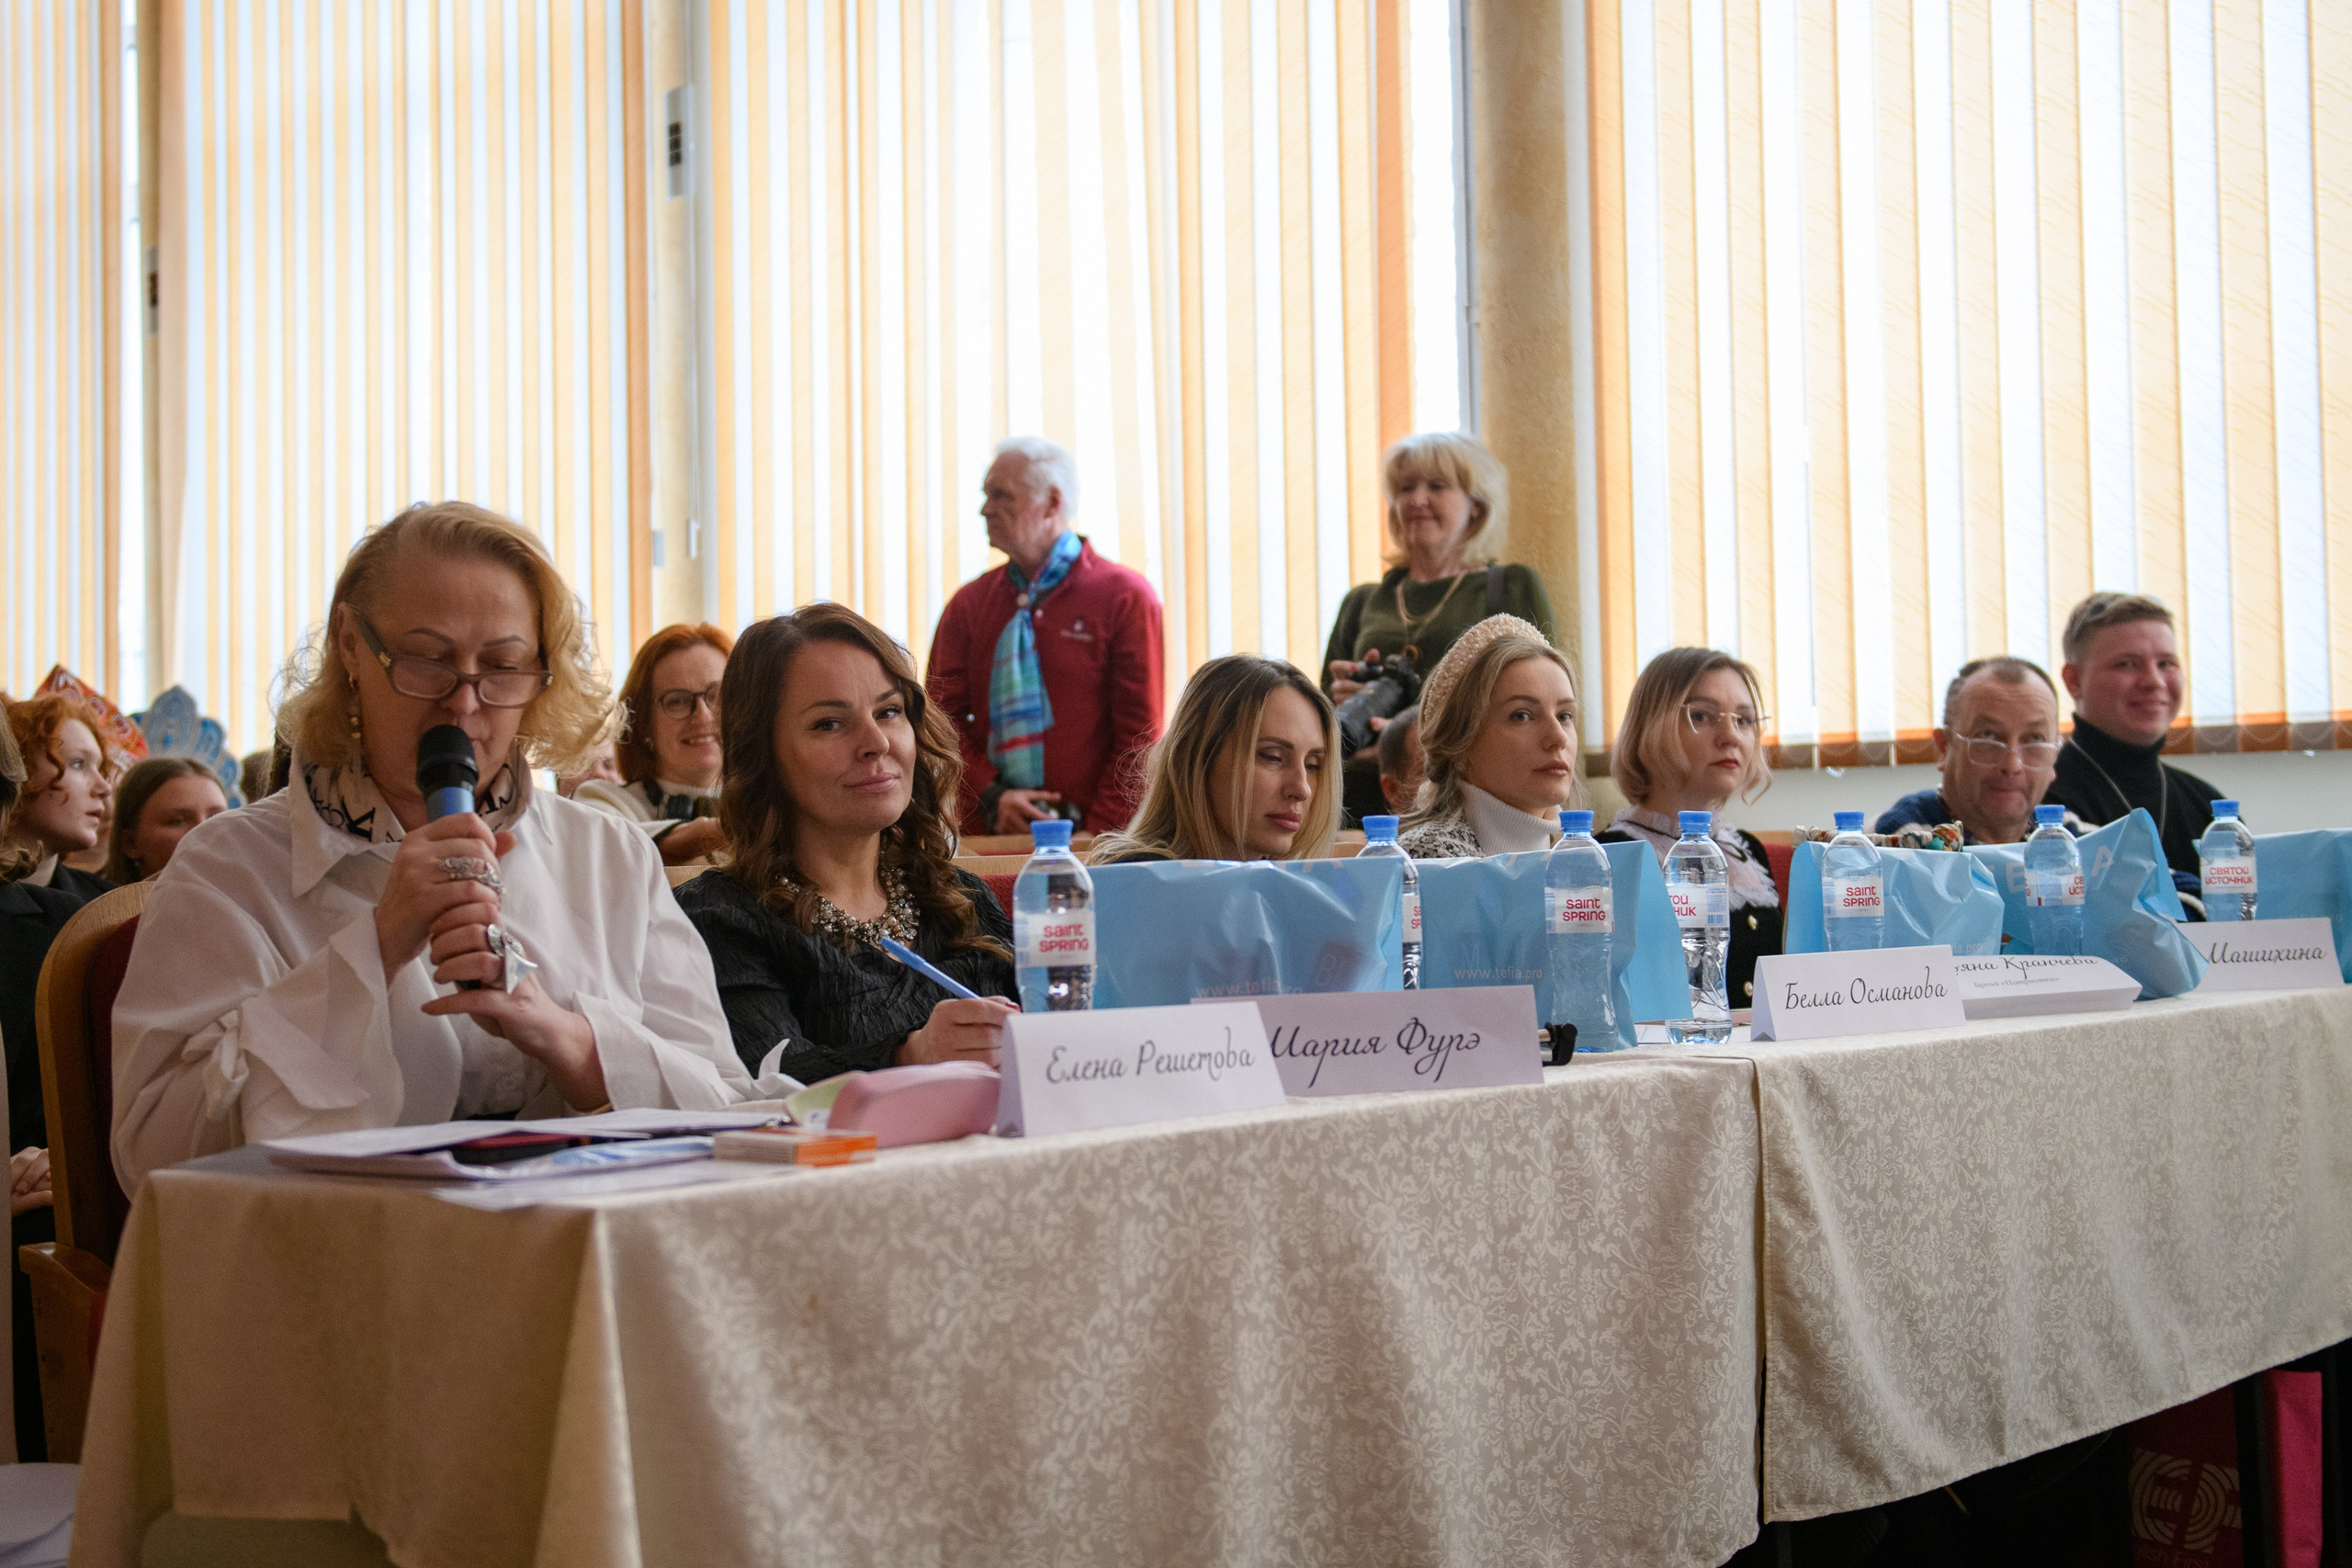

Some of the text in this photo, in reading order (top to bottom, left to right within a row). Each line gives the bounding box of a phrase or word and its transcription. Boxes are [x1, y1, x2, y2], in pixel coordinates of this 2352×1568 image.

[1562, 910, 1606, 921] SPRING
[1785, 965, 1949, 1010] Белла Османова
[1046, 1025, 1257, 1084] Елена Решетова
[1396, 1017, 1481, 1083] Фурэ
